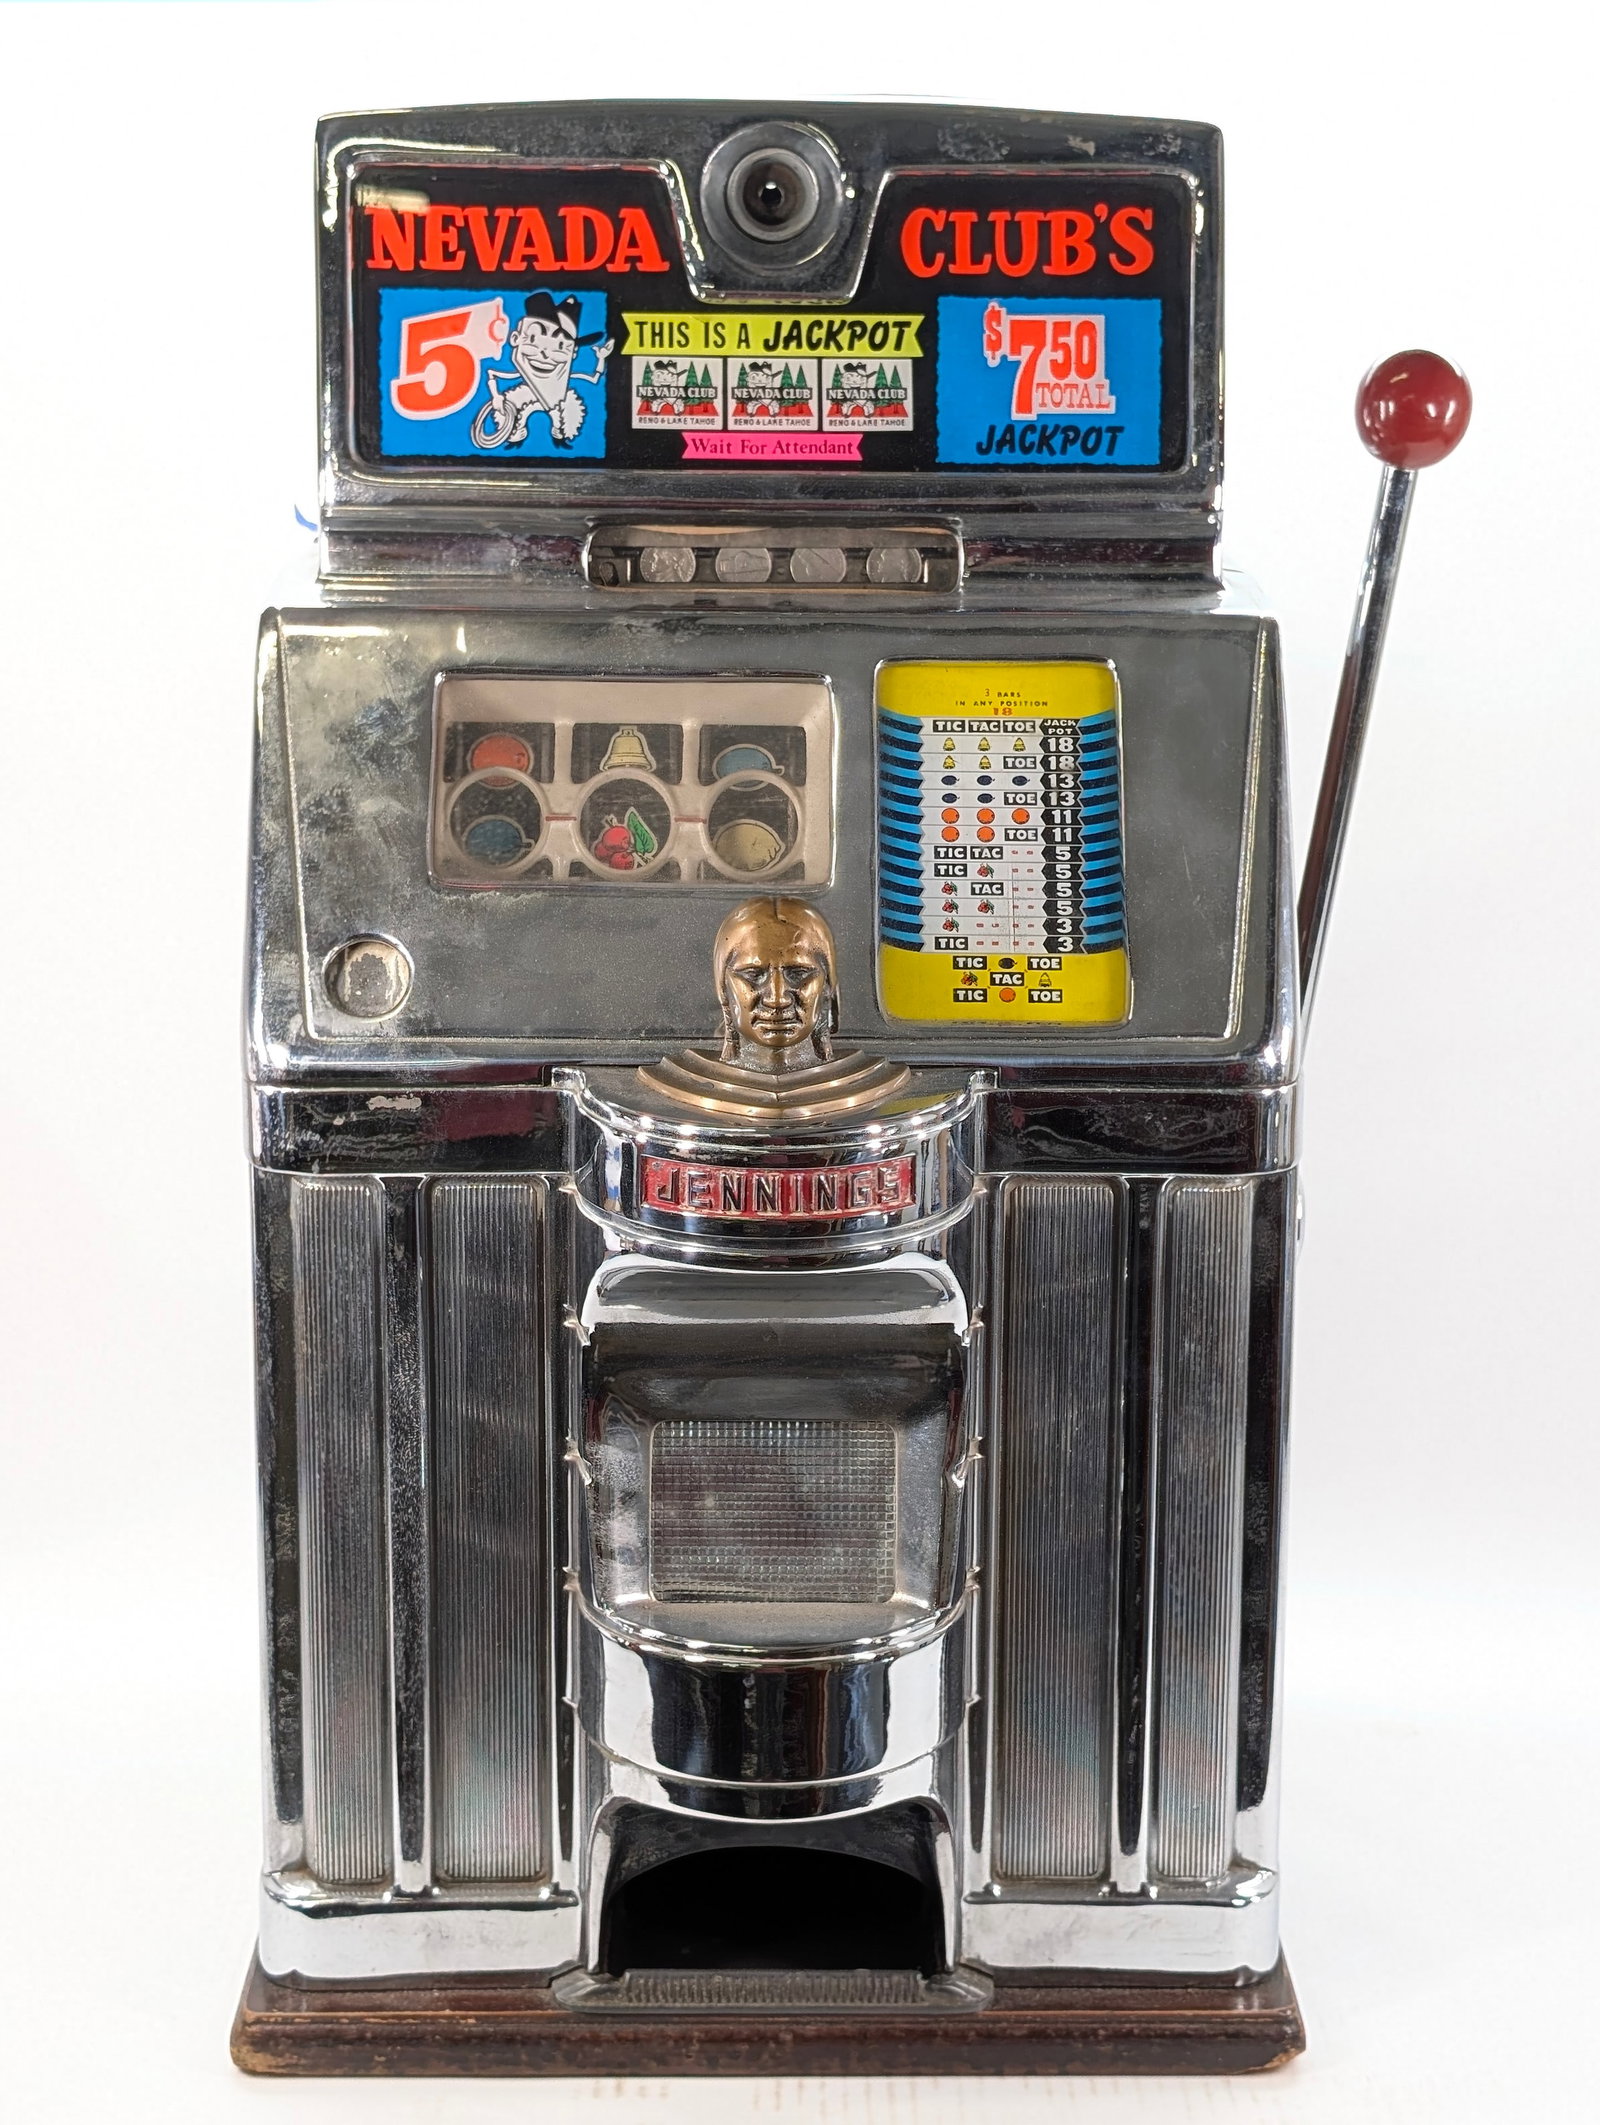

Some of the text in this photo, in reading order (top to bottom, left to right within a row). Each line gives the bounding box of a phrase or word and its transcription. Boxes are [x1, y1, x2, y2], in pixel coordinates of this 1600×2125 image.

[364, 203, 1154, 278] NEVADA CLUB'S
[634, 319, 912, 352] THIS IS A JACKPOT
[637, 387, 716, 399] NEVADA CLUB
[732, 387, 811, 400] NEVADA CLUB
[827, 388, 906, 400] NEVADA CLUB
[1035, 382, 1111, 409] TOTAL
[638, 417, 659, 425] RENO
[667, 418, 688, 426] LAKE
[689, 418, 716, 426] TAHOE
[733, 418, 754, 426] RENO
[762, 418, 783, 426] LAKE
[784, 418, 811, 427] TAHOE
[828, 419, 849, 427] RENO
[858, 419, 878, 427] LAKE
[879, 419, 906, 427] TAHOE
[691, 438, 853, 455] Wait For Attendant
[975, 424, 1125, 457] JACKPOT
[993, 707, 1013, 716] 18
[936, 721, 963, 731] TIC
[970, 721, 999, 731] TAC
[1004, 721, 1034, 732] TOE
[1047, 738, 1074, 752] 18
[1005, 756, 1075, 770] TOE 18
[1048, 774, 1075, 789] 13
[1006, 792, 1076, 807] TOE 13
[1051, 809, 1072, 823] 11
[1007, 828, 1072, 842] TOE 11
[936, 846, 1071, 861] TIC TAC 5
[936, 864, 1071, 879] TIC 5
[973, 882, 1072, 898] TAC 5
[1056, 900, 1072, 915] 5
[1056, 918, 1073, 933] 3
[938, 936, 1074, 952] TIC 3
[956, 957, 1060, 969] TIC TOE
[993, 974, 1022, 984] TAC
[956, 990, 1061, 1002] TIC TOE
[656, 1166, 900, 1212] JENNINGS
